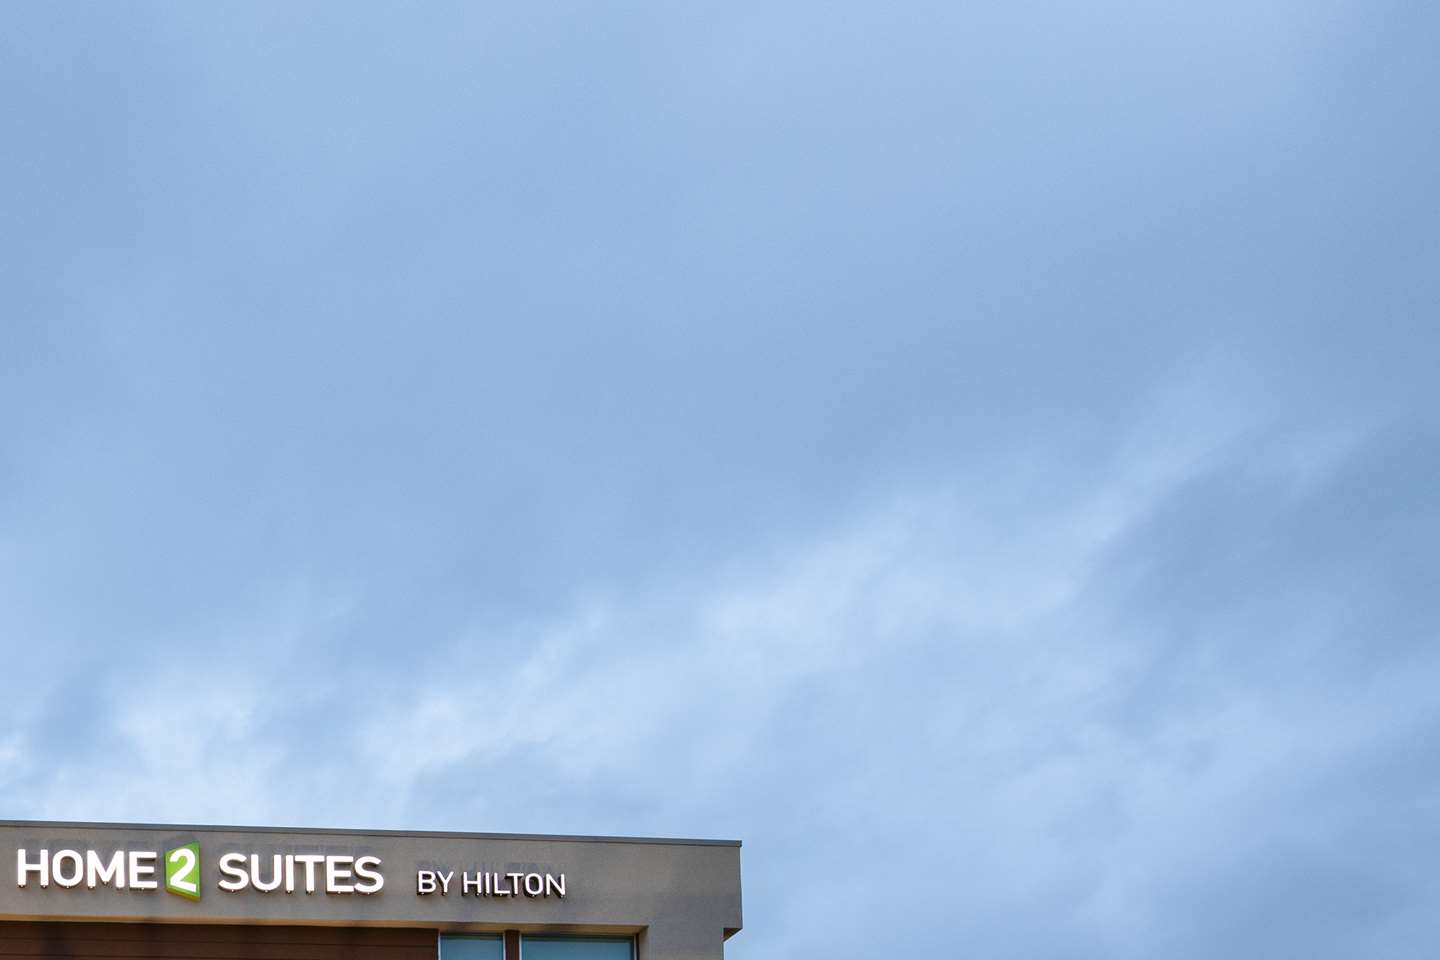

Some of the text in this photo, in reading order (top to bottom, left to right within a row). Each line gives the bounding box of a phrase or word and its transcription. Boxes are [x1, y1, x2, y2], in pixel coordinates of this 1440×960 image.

[218, 852, 385, 894] SUITES
[416, 870, 454, 895] BY
[462, 870, 566, 896] HILTON
